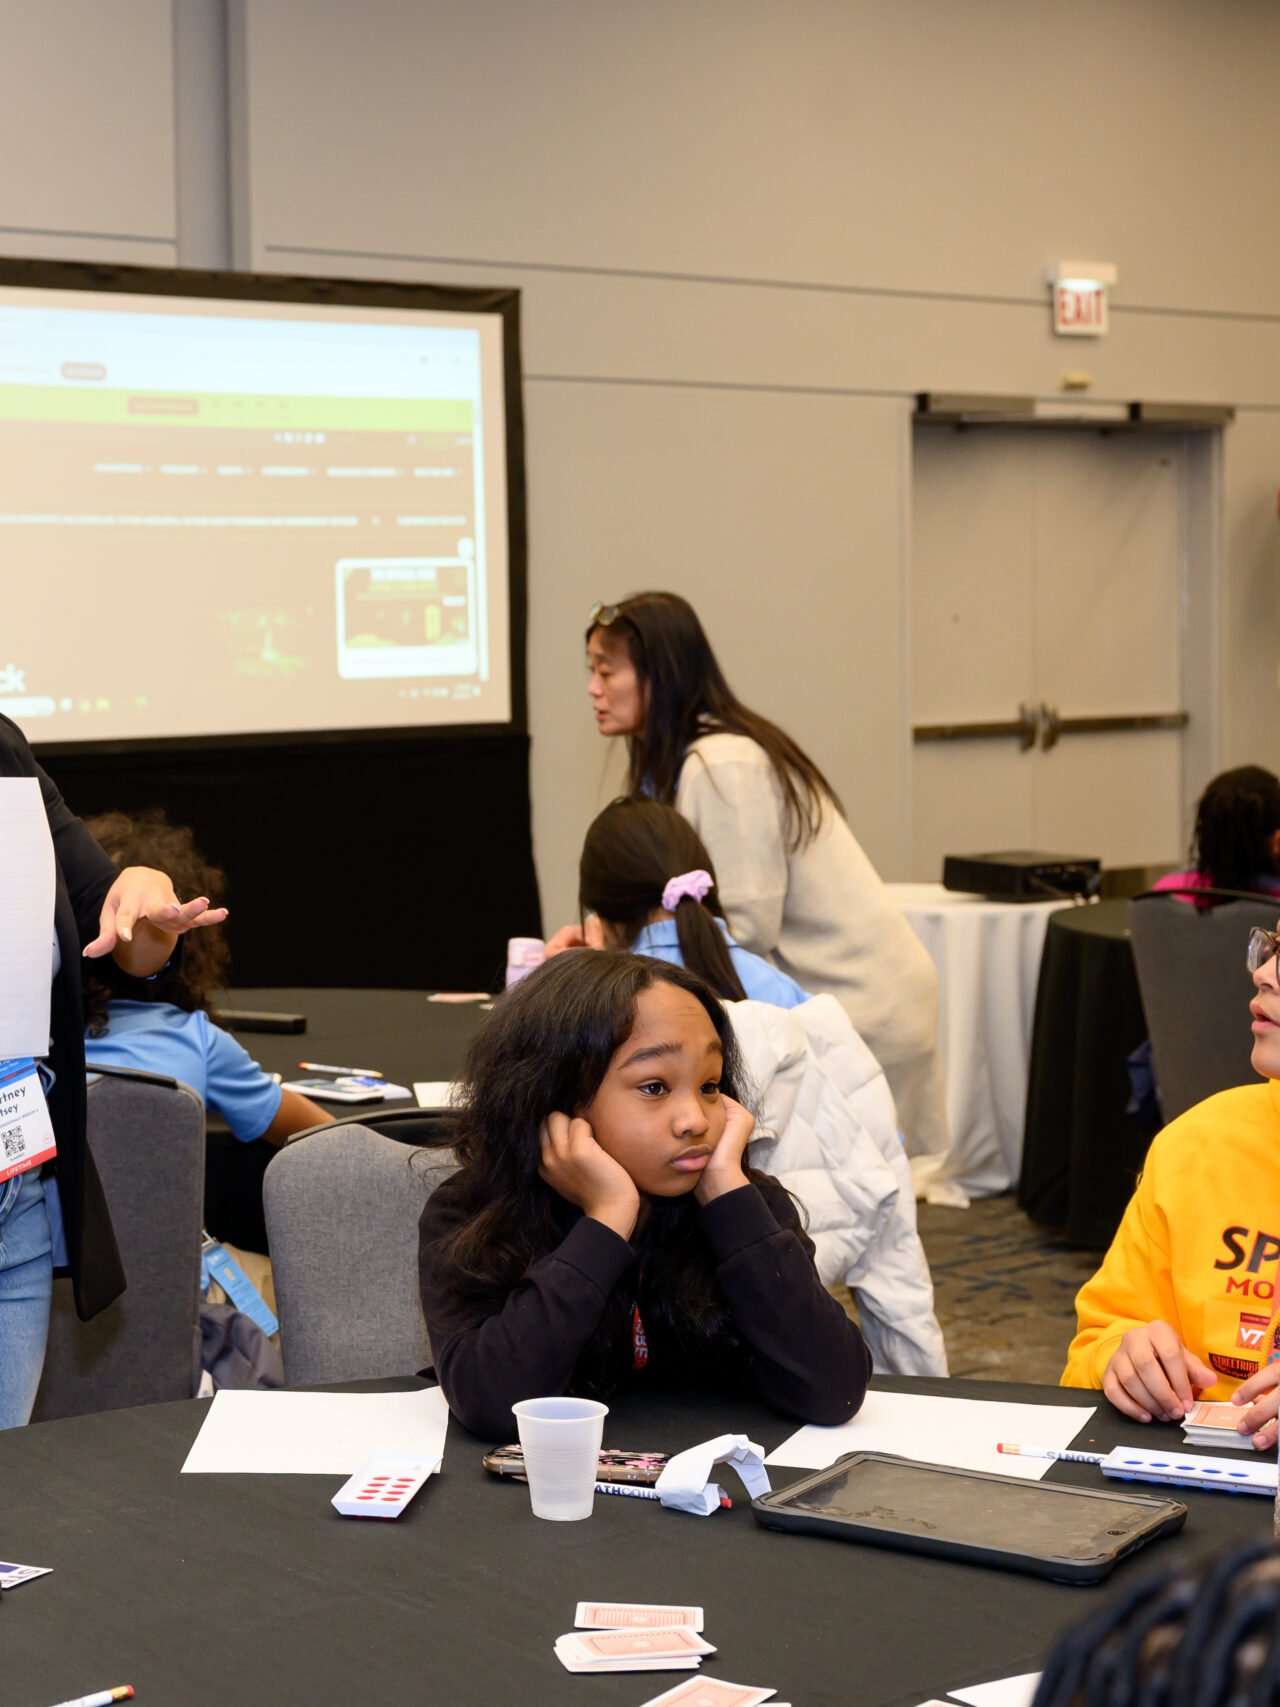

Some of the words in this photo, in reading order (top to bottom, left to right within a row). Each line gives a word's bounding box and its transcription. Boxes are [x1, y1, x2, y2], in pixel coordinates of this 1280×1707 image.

[1059, 287, 1102, 325] EXIT
[6, 1160, 32, 1176] LIFETIME
[633, 1319, 649, 1359] SBE
[1241, 1327, 1267, 1345] VT
